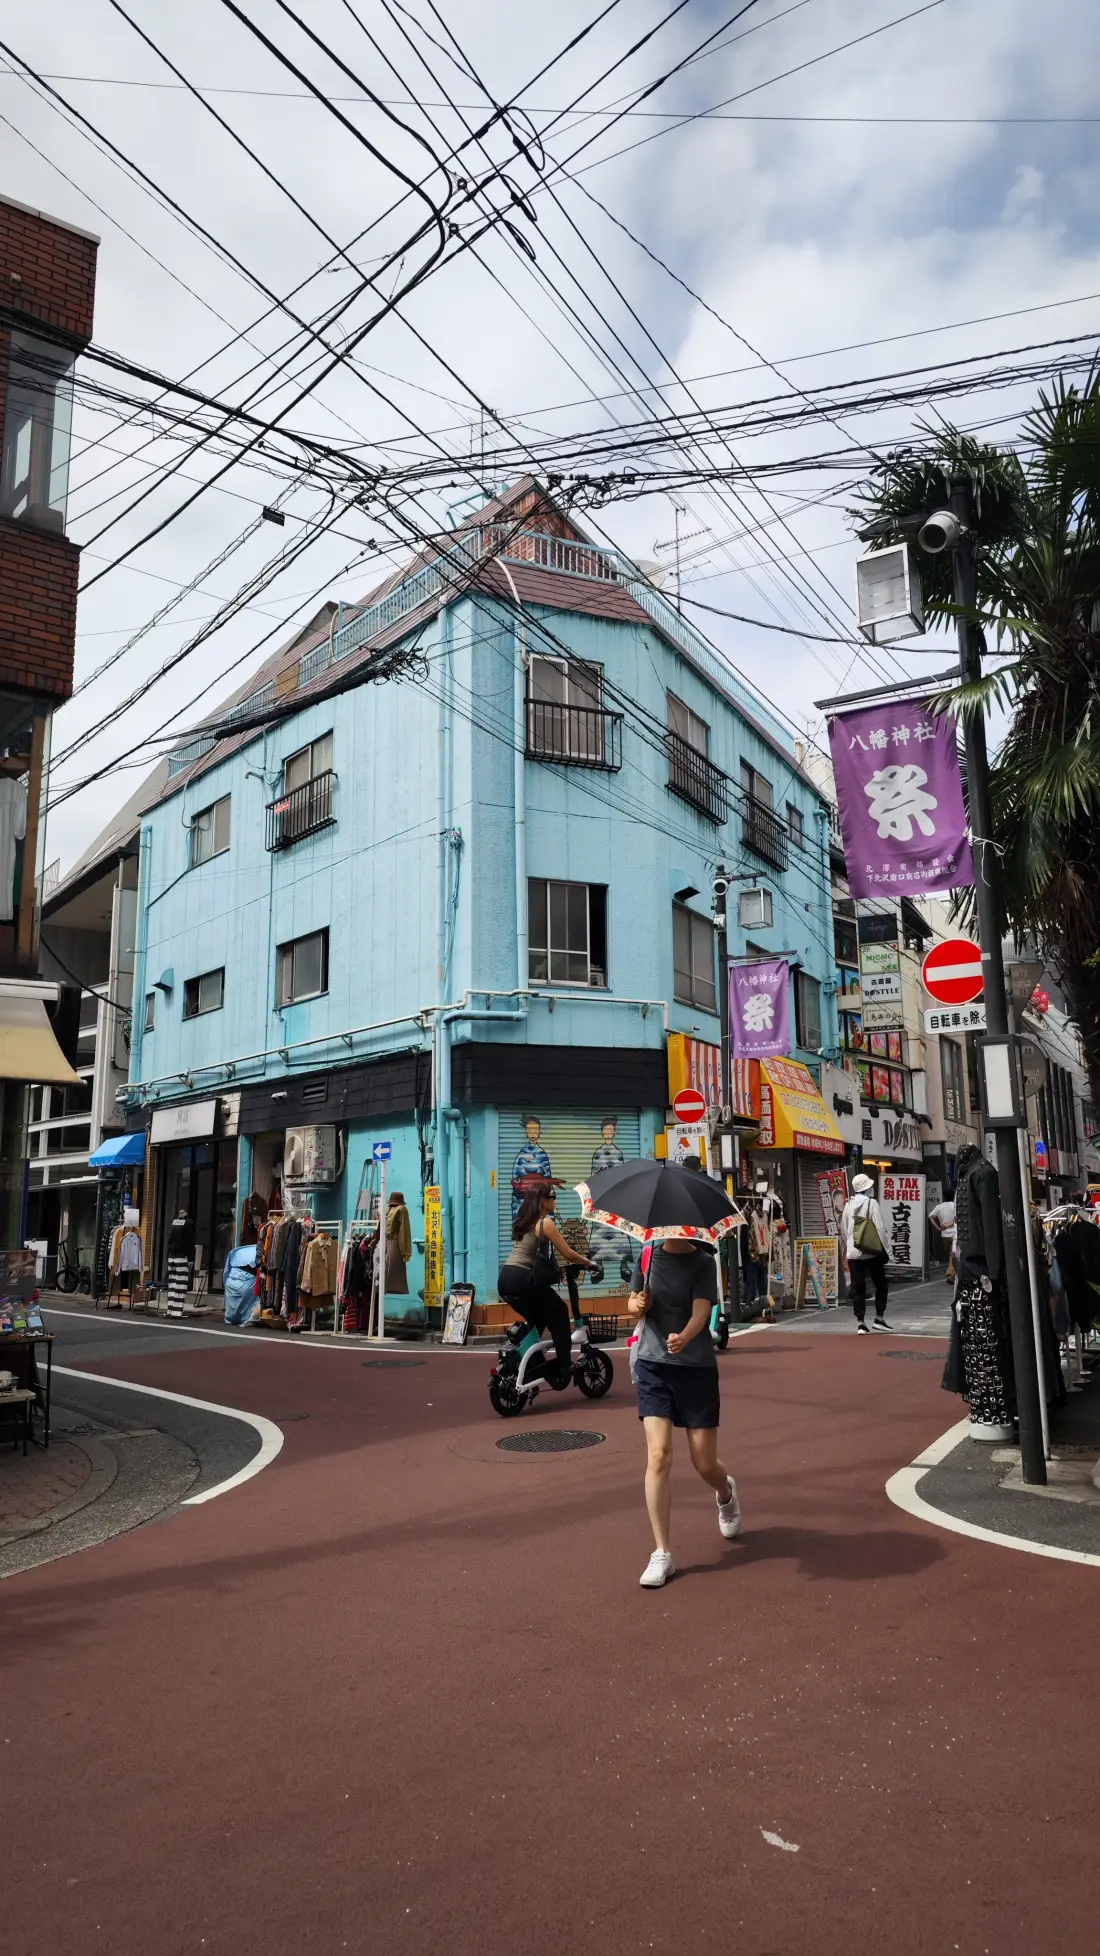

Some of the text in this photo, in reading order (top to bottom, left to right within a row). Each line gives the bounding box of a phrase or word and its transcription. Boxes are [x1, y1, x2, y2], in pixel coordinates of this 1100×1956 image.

[848, 722, 936, 751] 八幡神社
[864, 764, 938, 842] 祭
[739, 973, 778, 986] 八幡神社
[742, 993, 775, 1032] 祭
[897, 1190, 920, 1201] FREE
[898, 1178, 918, 1188] TAX
[891, 1201, 912, 1264] 古着屋
